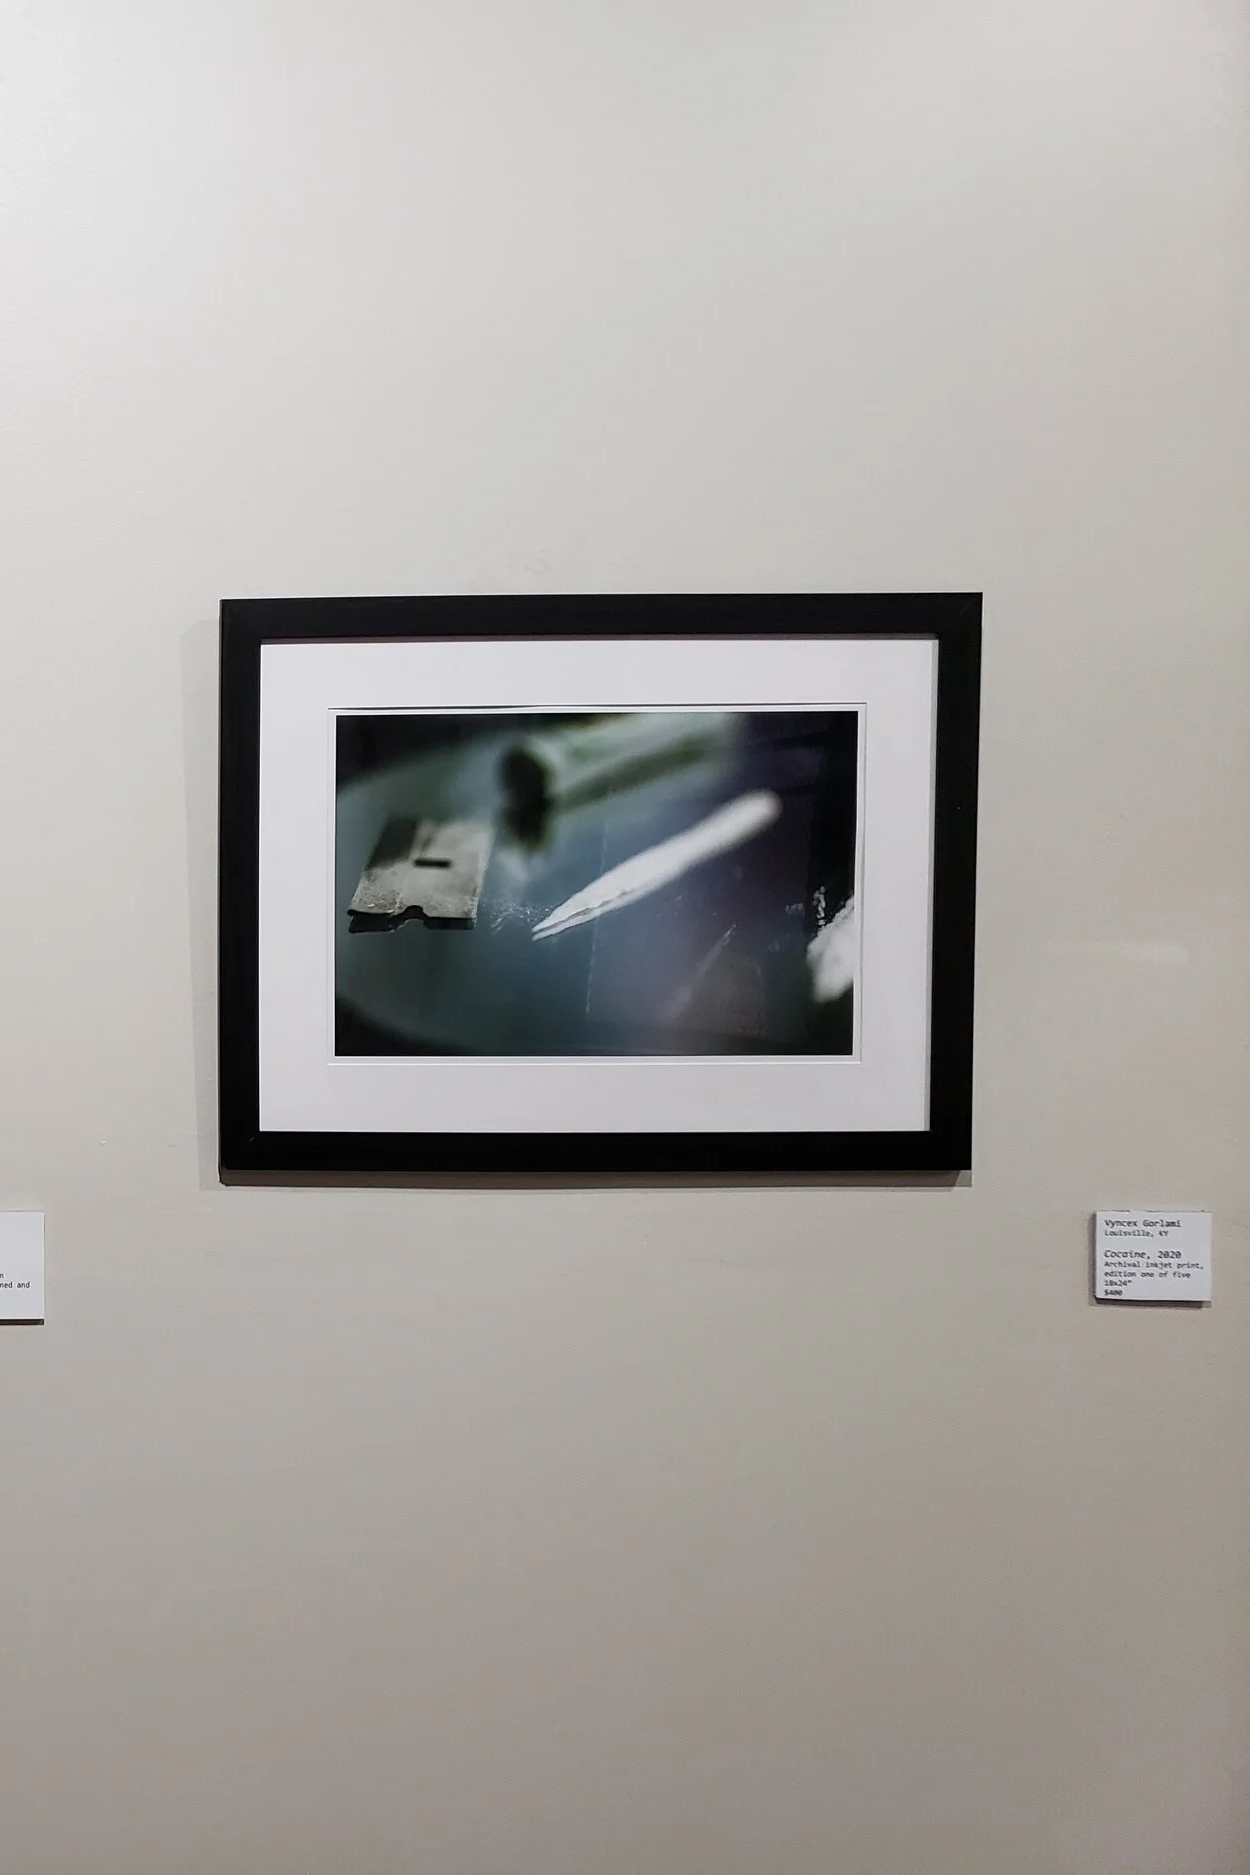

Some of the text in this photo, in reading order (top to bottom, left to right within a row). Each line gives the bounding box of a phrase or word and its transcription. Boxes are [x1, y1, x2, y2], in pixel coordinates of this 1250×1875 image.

[1104, 1219, 1181, 1228] Vyncex Gorlami
[1104, 1229, 1154, 1237] Louisville,
[1104, 1249, 1182, 1260] Cocaine, 2020
[1145, 1261, 1172, 1270] inkjet
[1176, 1261, 1204, 1270] print,
[17, 1281, 31, 1289] and
